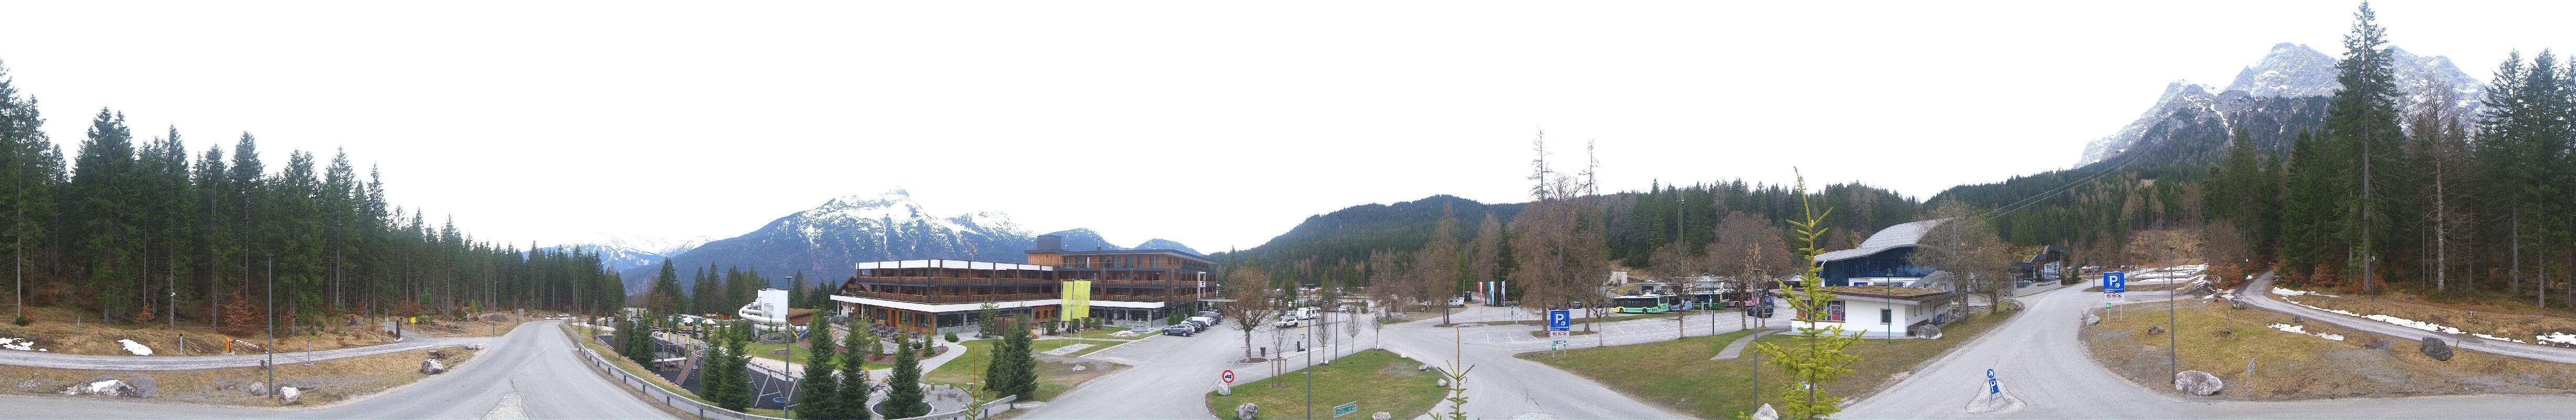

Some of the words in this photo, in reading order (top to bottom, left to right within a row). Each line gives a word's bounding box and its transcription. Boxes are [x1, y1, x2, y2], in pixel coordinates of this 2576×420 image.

[2109, 276, 2118, 286] P
[1555, 313, 1564, 324] P
[1990, 380, 1996, 394] P
